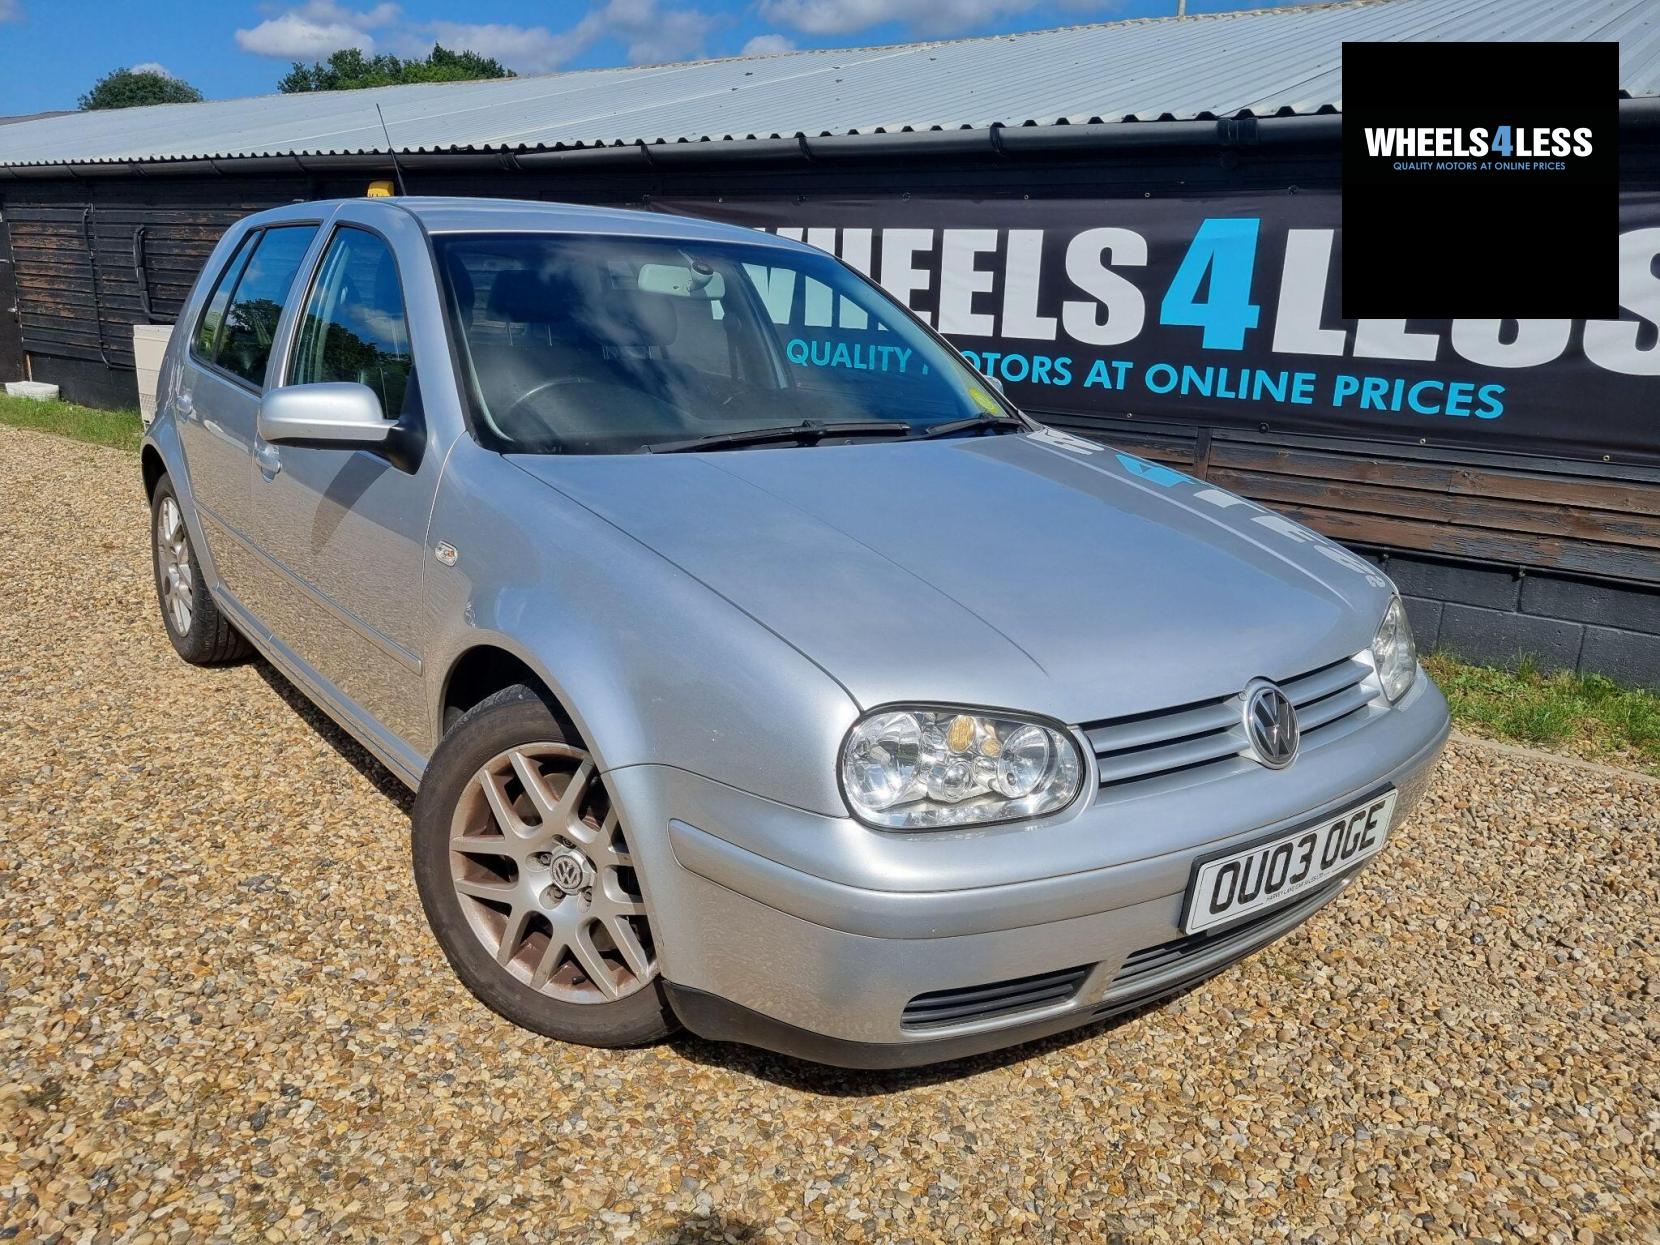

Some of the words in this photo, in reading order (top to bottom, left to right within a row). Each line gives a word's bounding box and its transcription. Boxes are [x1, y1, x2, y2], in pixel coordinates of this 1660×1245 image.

[786, 339, 912, 373] QUALITY
[1084, 360, 1134, 390] AT
[1145, 363, 1316, 405] ONLINE
[1333, 375, 1505, 419] PRICES
[1210, 834, 1317, 914] OU03
[1321, 802, 1385, 870] OGE
